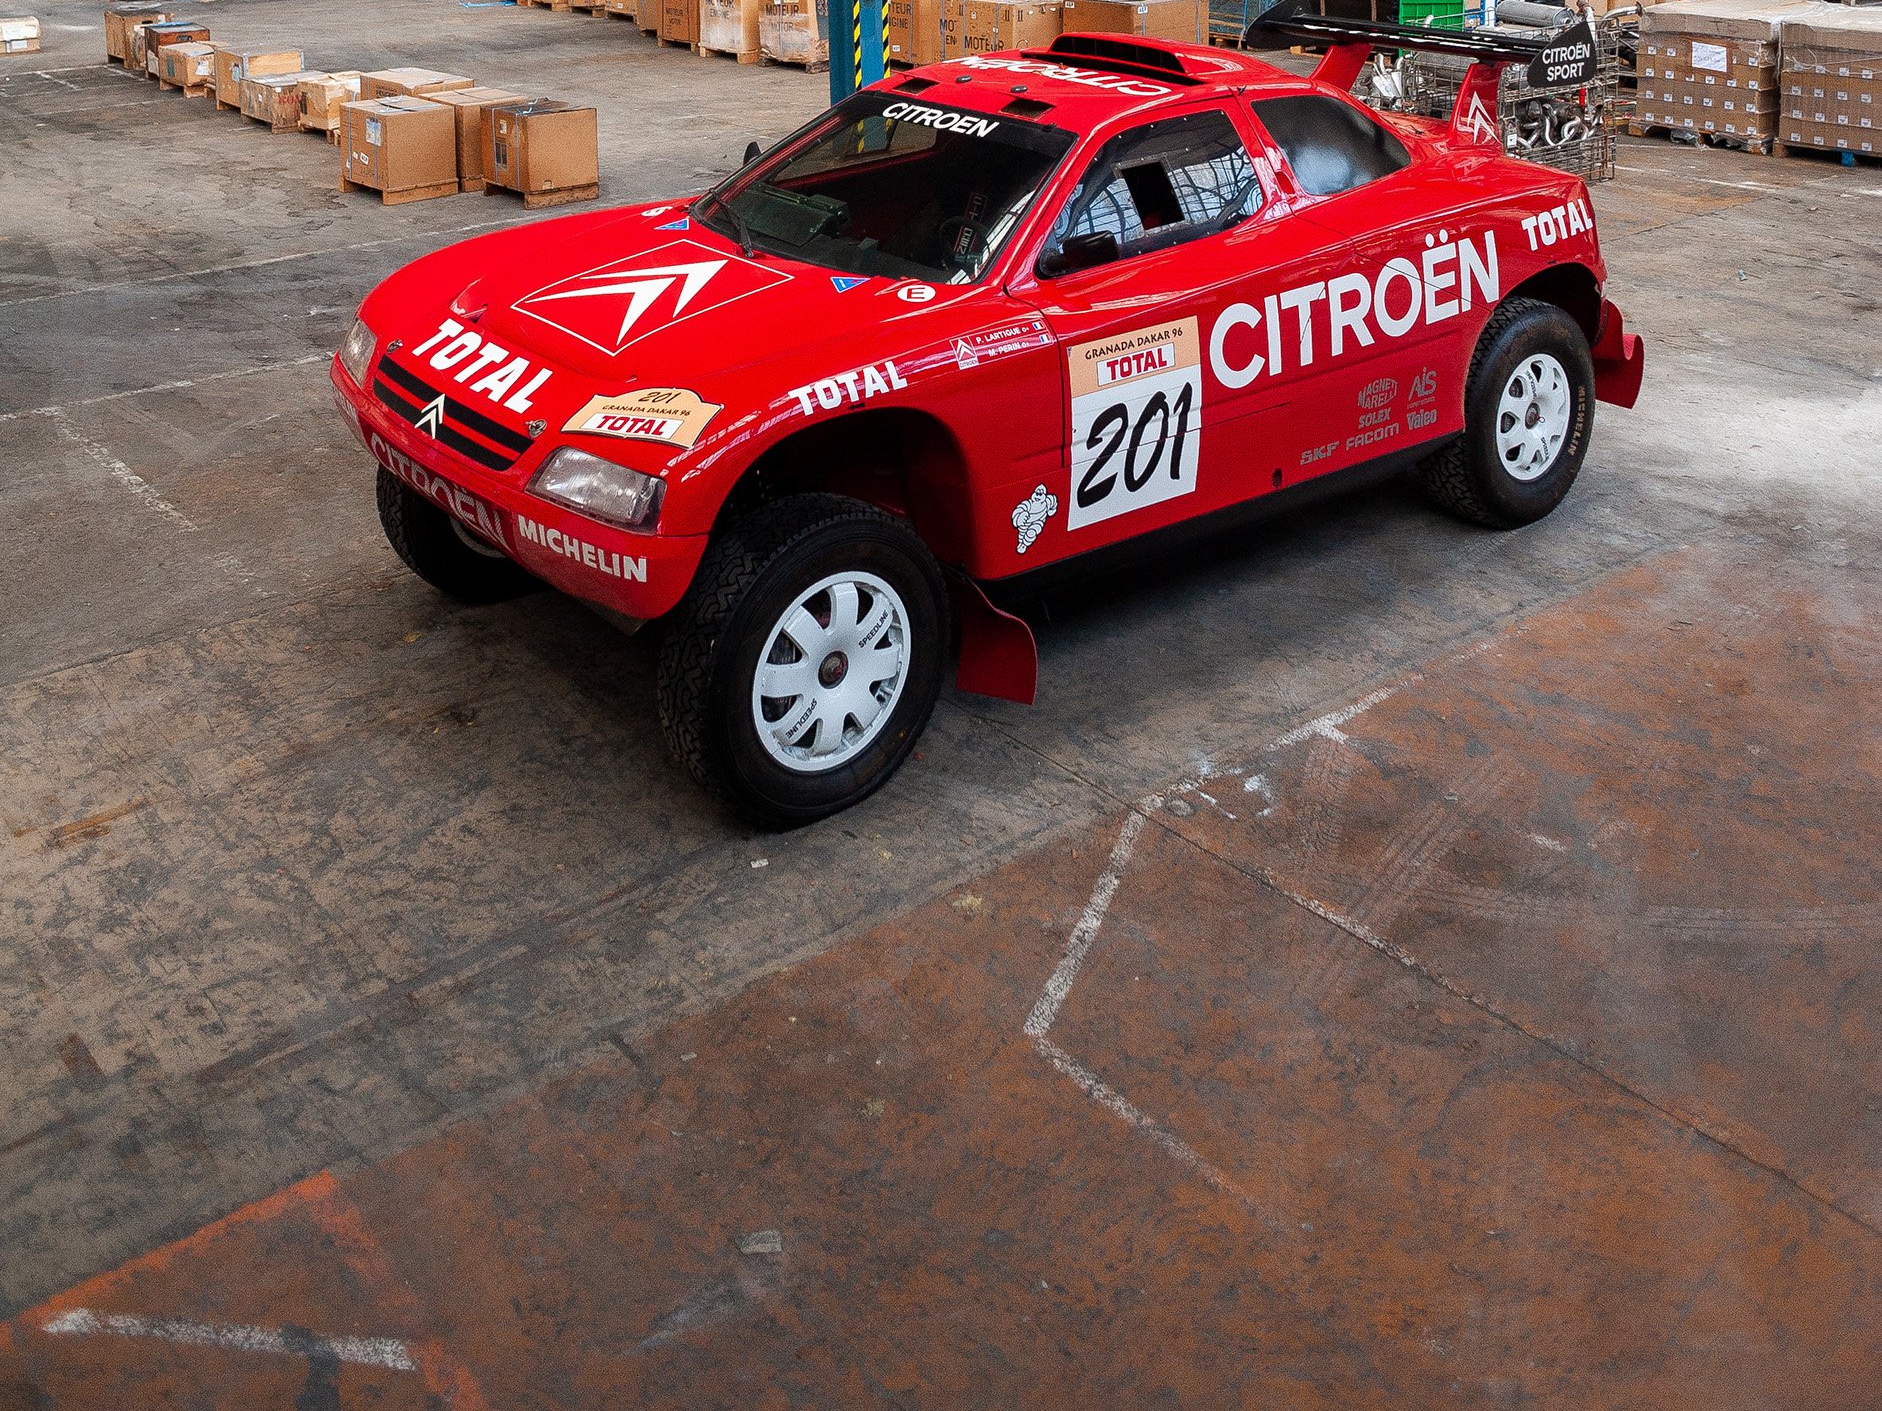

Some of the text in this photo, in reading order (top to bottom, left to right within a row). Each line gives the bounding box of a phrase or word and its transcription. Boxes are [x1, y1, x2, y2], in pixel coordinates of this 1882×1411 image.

[766, 4, 799, 17] MOTEUR
[964, 36, 1005, 52] MOTEUR
[1541, 43, 1591, 65] CITROËN
[1547, 61, 1585, 81] SPORT
[882, 102, 1000, 138] CITROEN
[1520, 198, 1594, 251] TOTAL
[906, 287, 926, 299] E
[1209, 228, 1500, 389] CITROËN
[984, 327, 1021, 342] LARTIGUE
[1085, 326, 1183, 360] GRANADA DAKAR 96
[999, 342, 1021, 354] PERIN
[411, 317, 554, 414] TOTAL
[1106, 347, 1168, 381] TOTAL
[638, 391, 682, 404] 201
[788, 360, 908, 416] TOTAL
[602, 404, 691, 417] GRANADA DAKAR 96
[1358, 408, 1391, 430] SOLEX
[1407, 409, 1437, 430] Valeo
[1567, 386, 1586, 457] MICHELIN
[596, 415, 668, 436] TOTAL
[1345, 423, 1399, 450] FACOM
[1077, 381, 1193, 508] 201
[1300, 441, 1339, 465] SKF
[518, 515, 648, 583] MICHELIN
[858, 609, 889, 649] SPEEDLINE
[786, 698, 818, 739] SPEEDLINE
